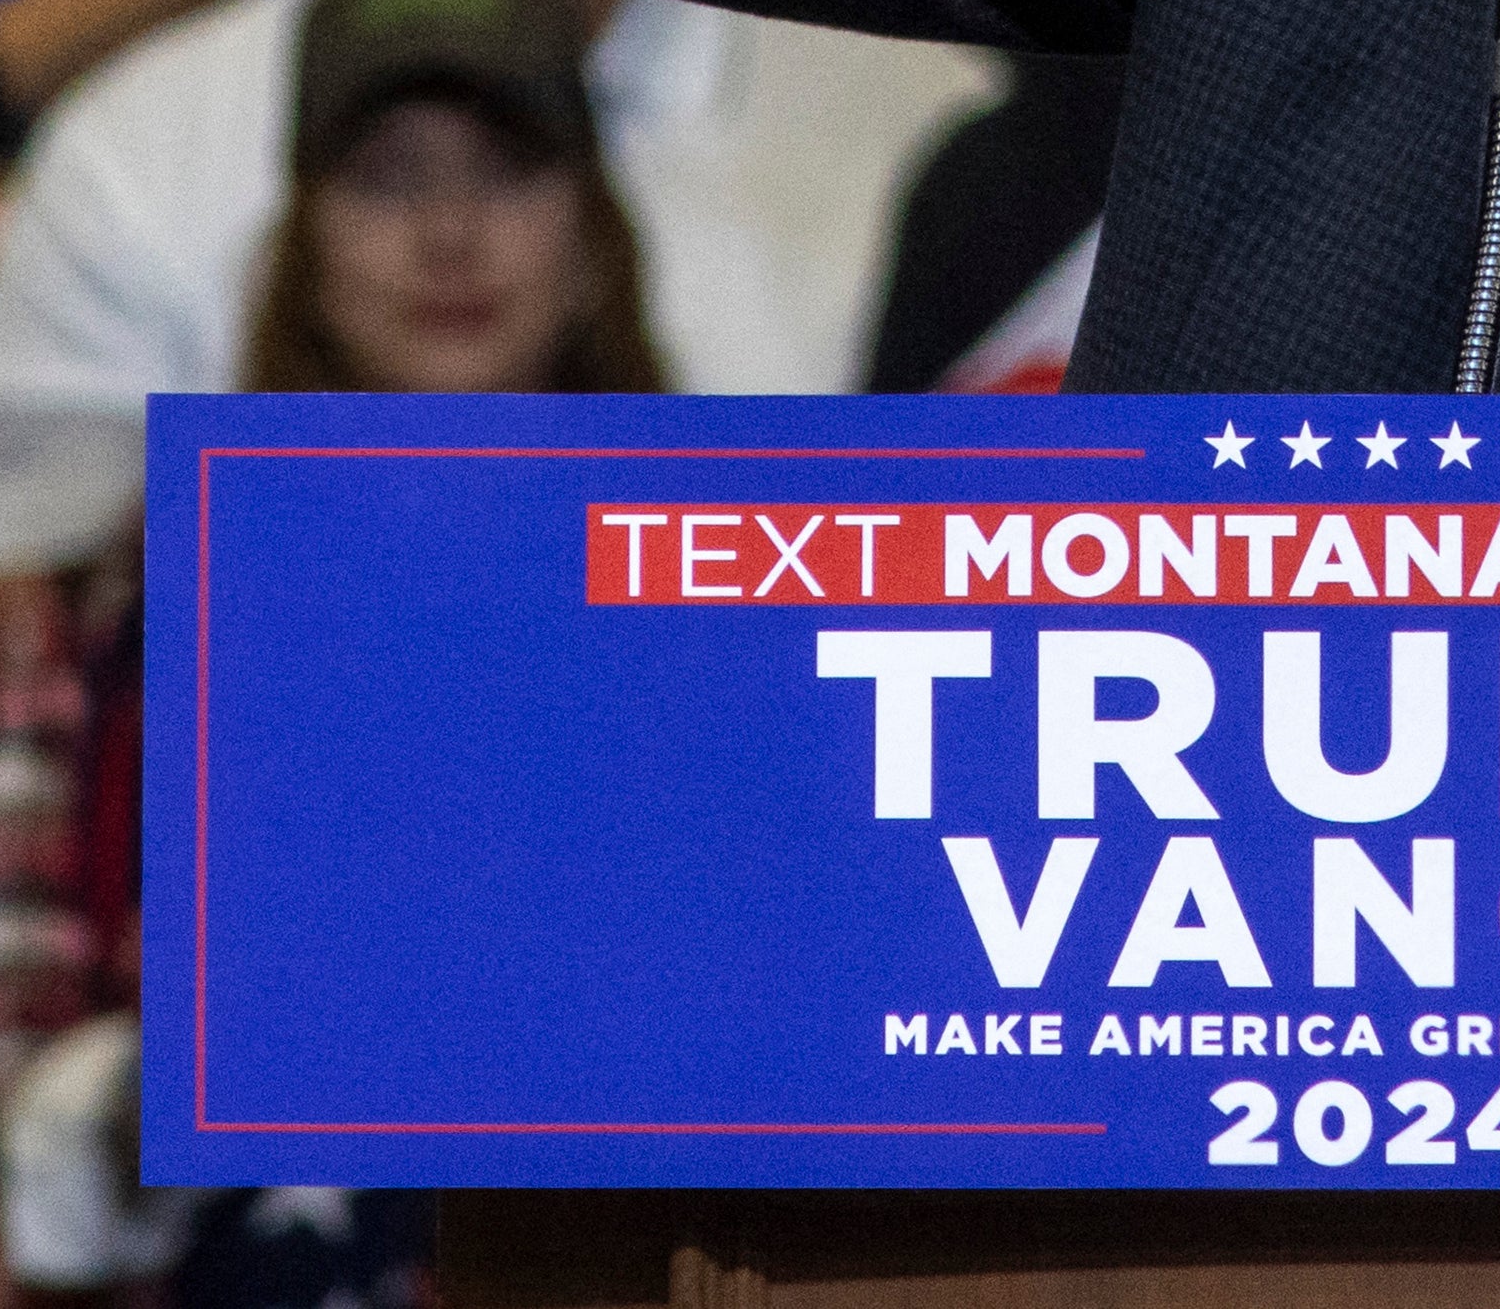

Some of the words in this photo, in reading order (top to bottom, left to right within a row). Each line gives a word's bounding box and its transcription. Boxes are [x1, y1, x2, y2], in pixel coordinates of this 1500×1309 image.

[602, 513, 900, 597] TEXT
[885, 1014, 1062, 1056] MAKE
[1090, 1014, 1383, 1056] AMERICA
